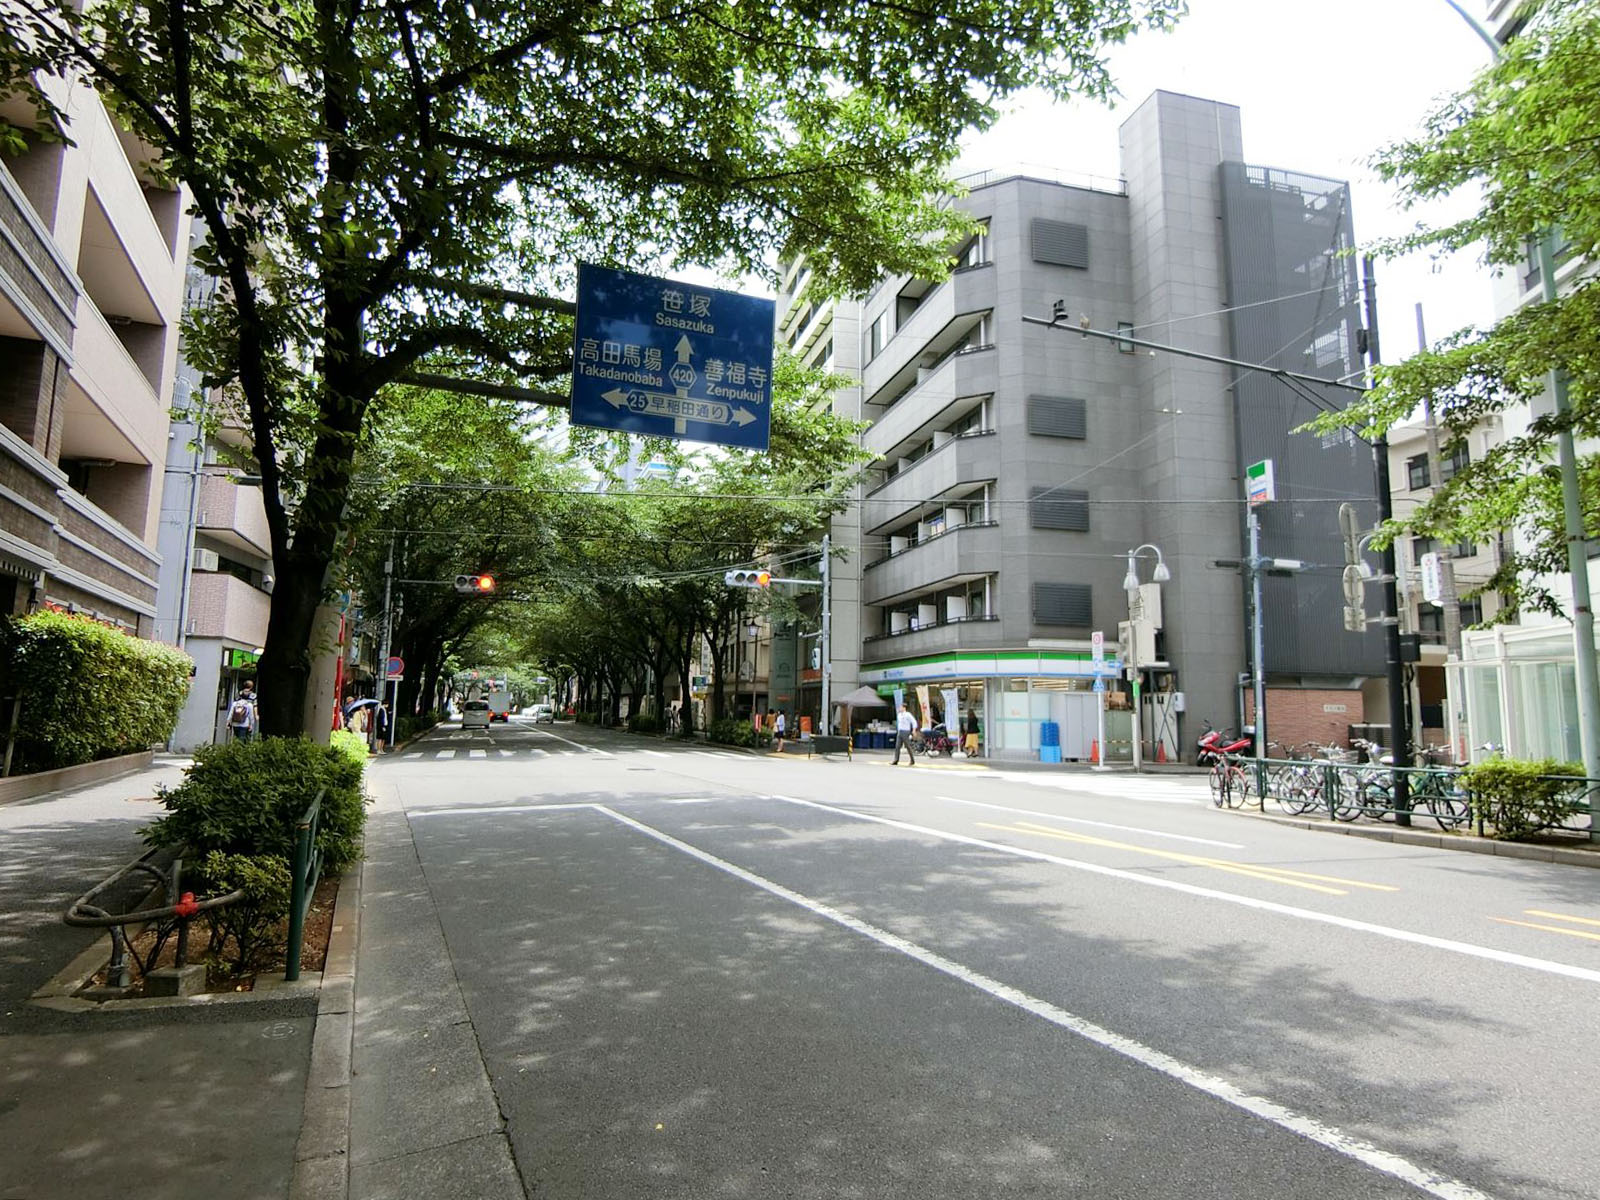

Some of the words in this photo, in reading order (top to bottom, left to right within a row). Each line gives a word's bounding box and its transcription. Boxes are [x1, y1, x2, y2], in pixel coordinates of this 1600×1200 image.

[661, 289, 711, 318] 笹塚
[655, 312, 715, 335] Sasazuka
[580, 337, 663, 372] 高田馬場
[578, 361, 663, 388] Takadanobaba
[672, 369, 693, 384] 420
[704, 357, 767, 389] 善福寺
[629, 394, 646, 409] 25
[706, 382, 764, 406] Zenpukuji
[650, 396, 724, 419] 早稲田通り
